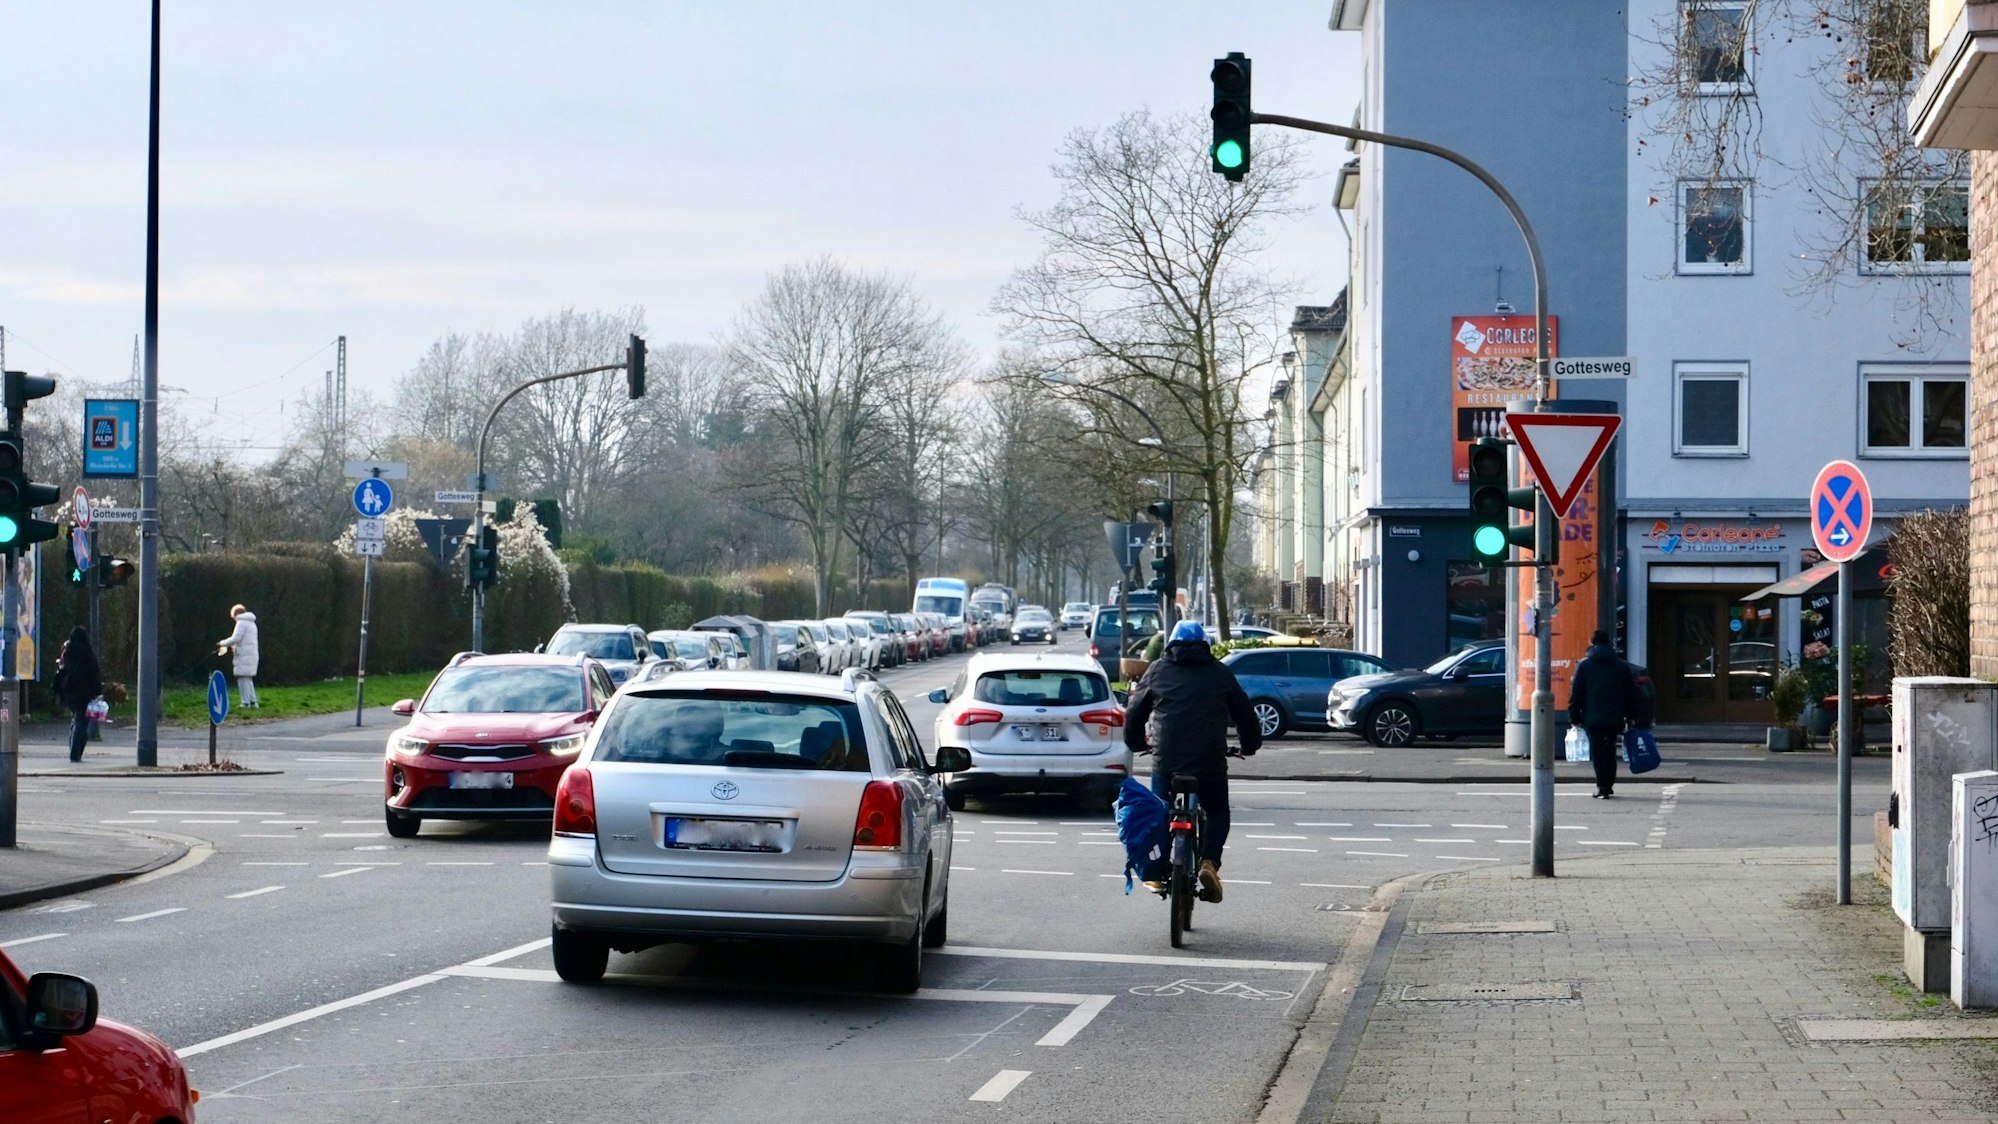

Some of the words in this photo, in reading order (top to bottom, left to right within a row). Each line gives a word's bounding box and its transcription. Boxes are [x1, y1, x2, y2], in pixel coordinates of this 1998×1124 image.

[1554, 360, 1631, 376] Gottesweg
[437, 492, 475, 502] Gottesweg
[92, 509, 138, 521] Gottesweg
[1681, 523, 1779, 543] Corleone
[1681, 543, 1740, 552] Steinofen
[1745, 543, 1779, 552] Pizza
[1811, 596, 1830, 609] PASTA
[1812, 627, 1831, 640] SALAT
